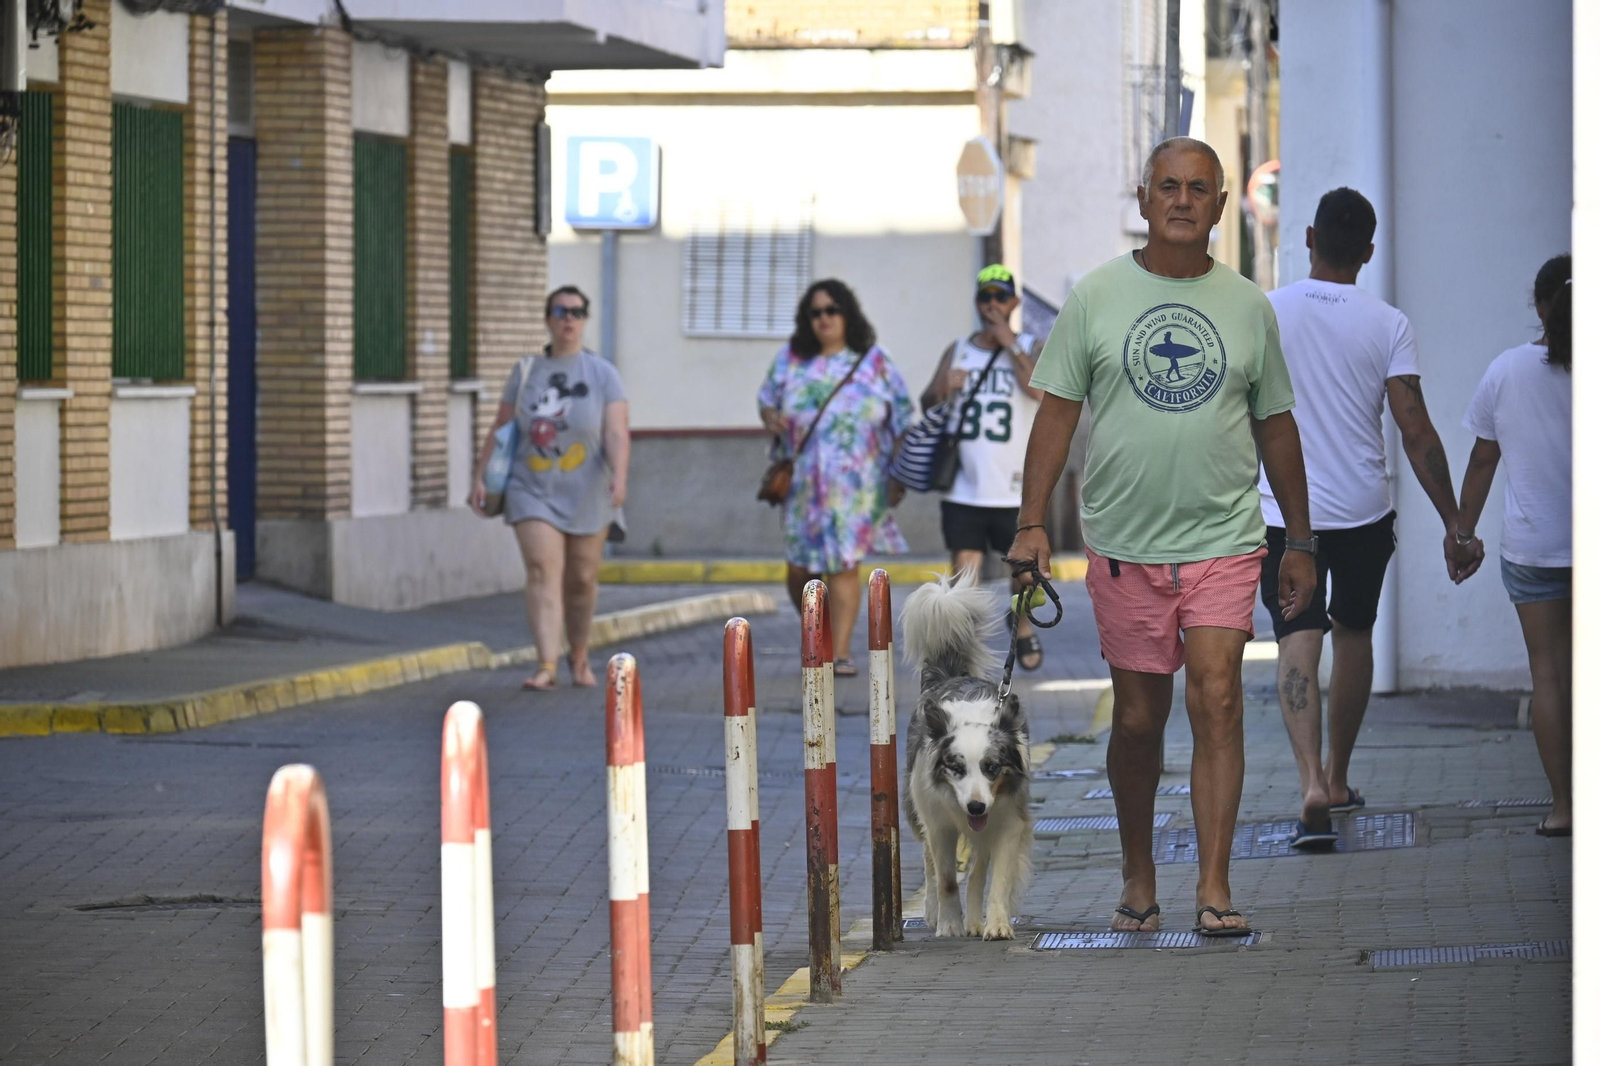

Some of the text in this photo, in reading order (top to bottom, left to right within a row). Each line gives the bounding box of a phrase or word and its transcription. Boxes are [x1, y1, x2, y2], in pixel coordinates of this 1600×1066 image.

[578, 141, 638, 217] P
[1305, 293, 1340, 303] GEORGE
[1132, 312, 1215, 367] SUN AND WIND GUARANTEED
[1147, 373, 1215, 403] CALIFORNIA
